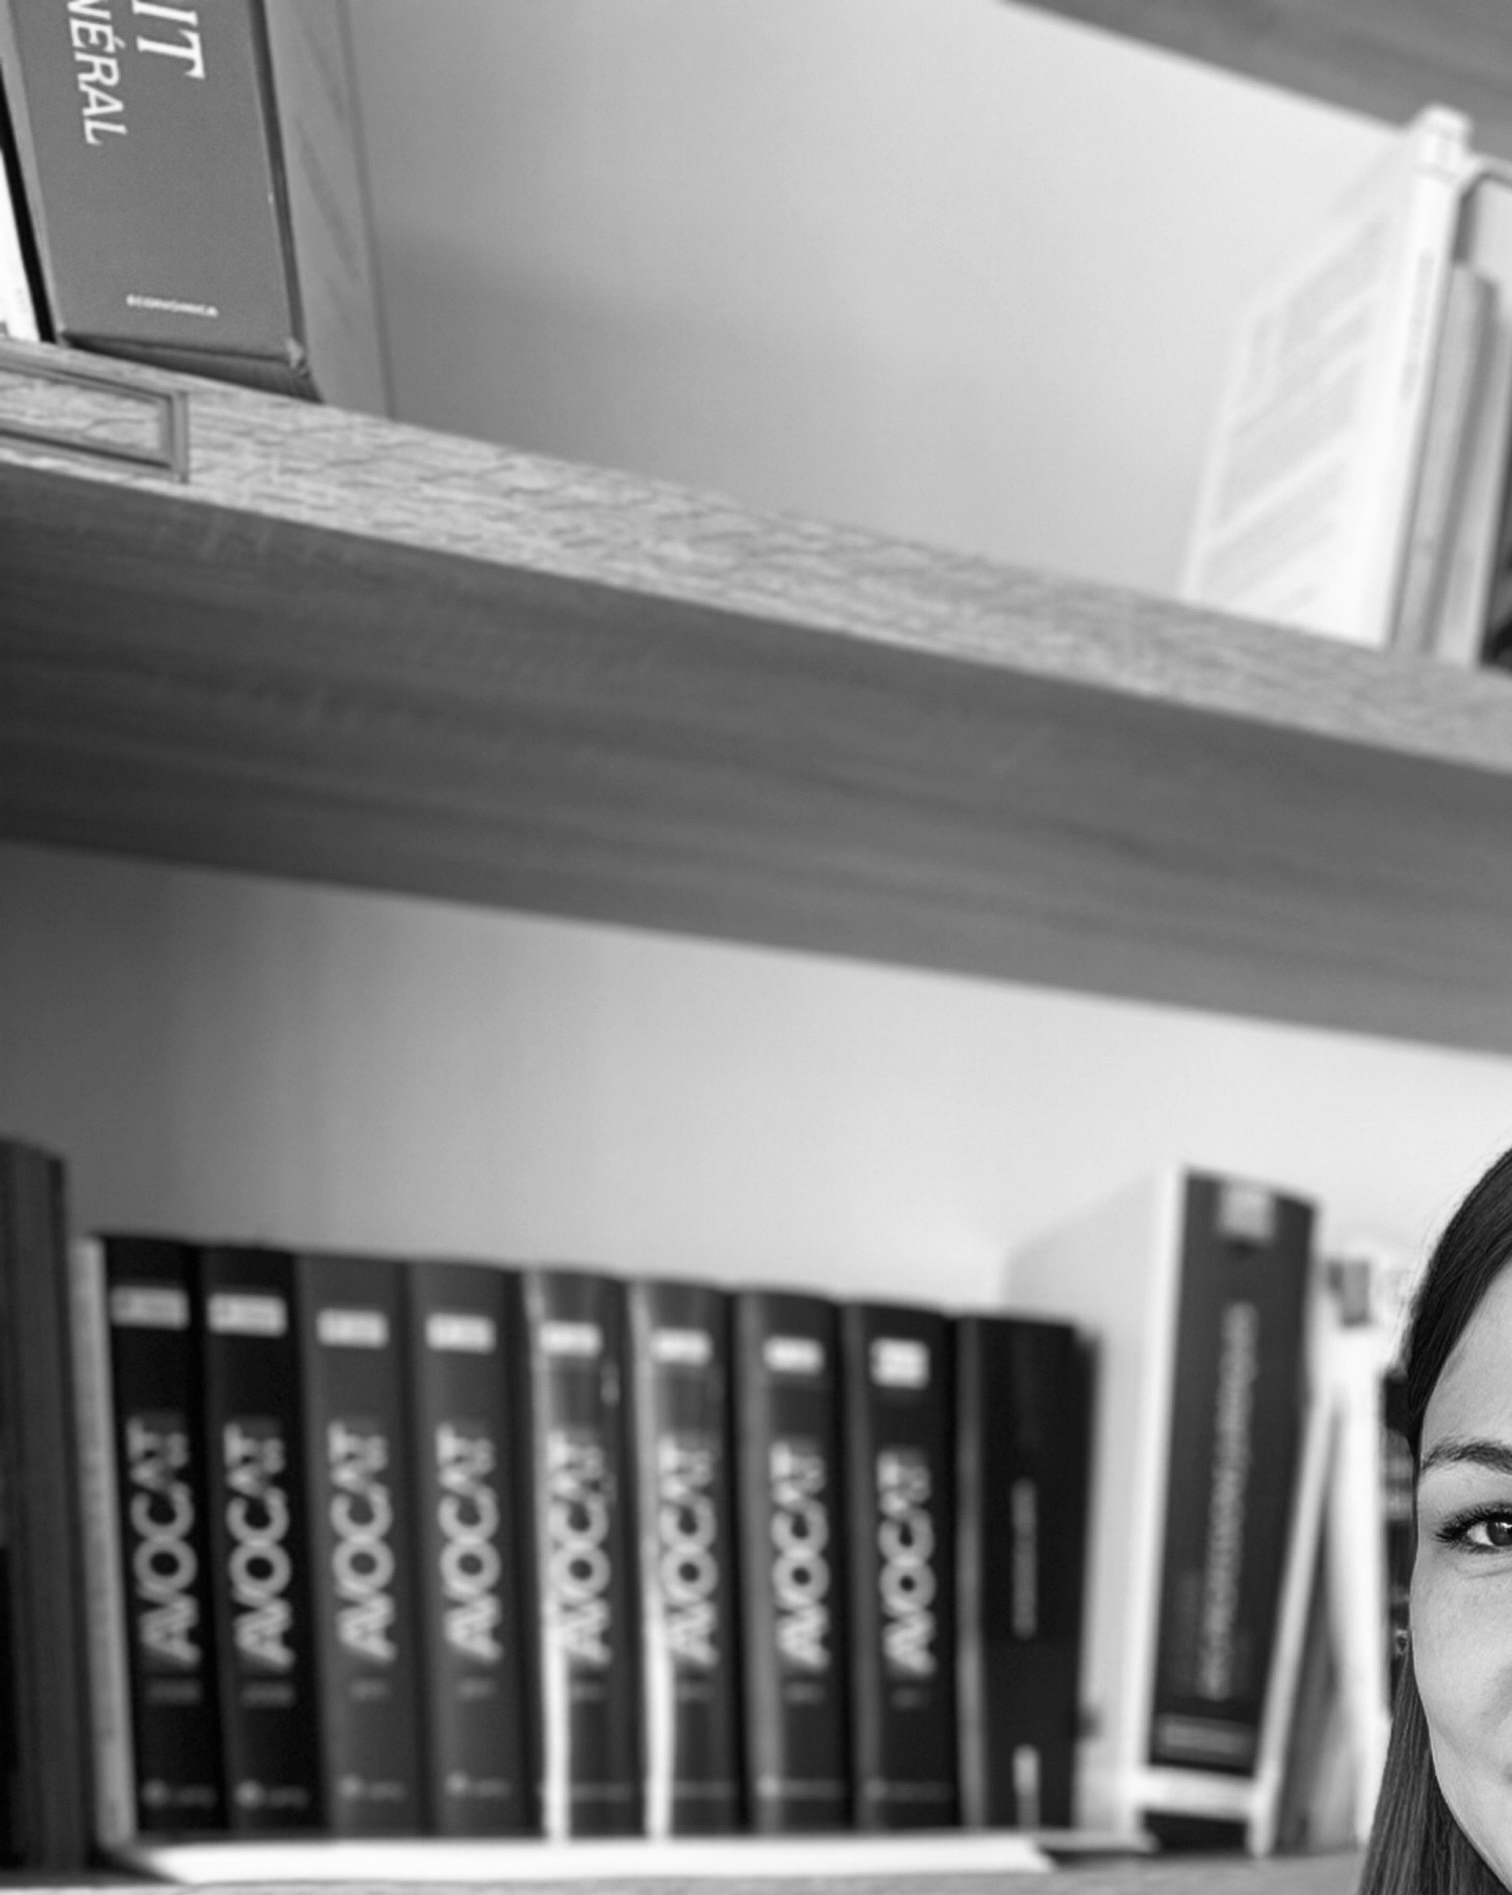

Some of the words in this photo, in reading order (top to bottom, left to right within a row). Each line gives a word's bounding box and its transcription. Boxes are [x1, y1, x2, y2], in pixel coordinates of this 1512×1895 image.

[125, 1415, 200, 1667] AVOCAT
[222, 1421, 295, 1672] AVOCAT
[328, 1419, 397, 1663] AVOCAT
[435, 1422, 502, 1664] AVOCAT
[546, 1428, 611, 1668] AVOCAT
[657, 1433, 718, 1671] AVOCAT
[769, 1439, 830, 1672] AVOCAT
[877, 1449, 935, 1676] AVOCAT
